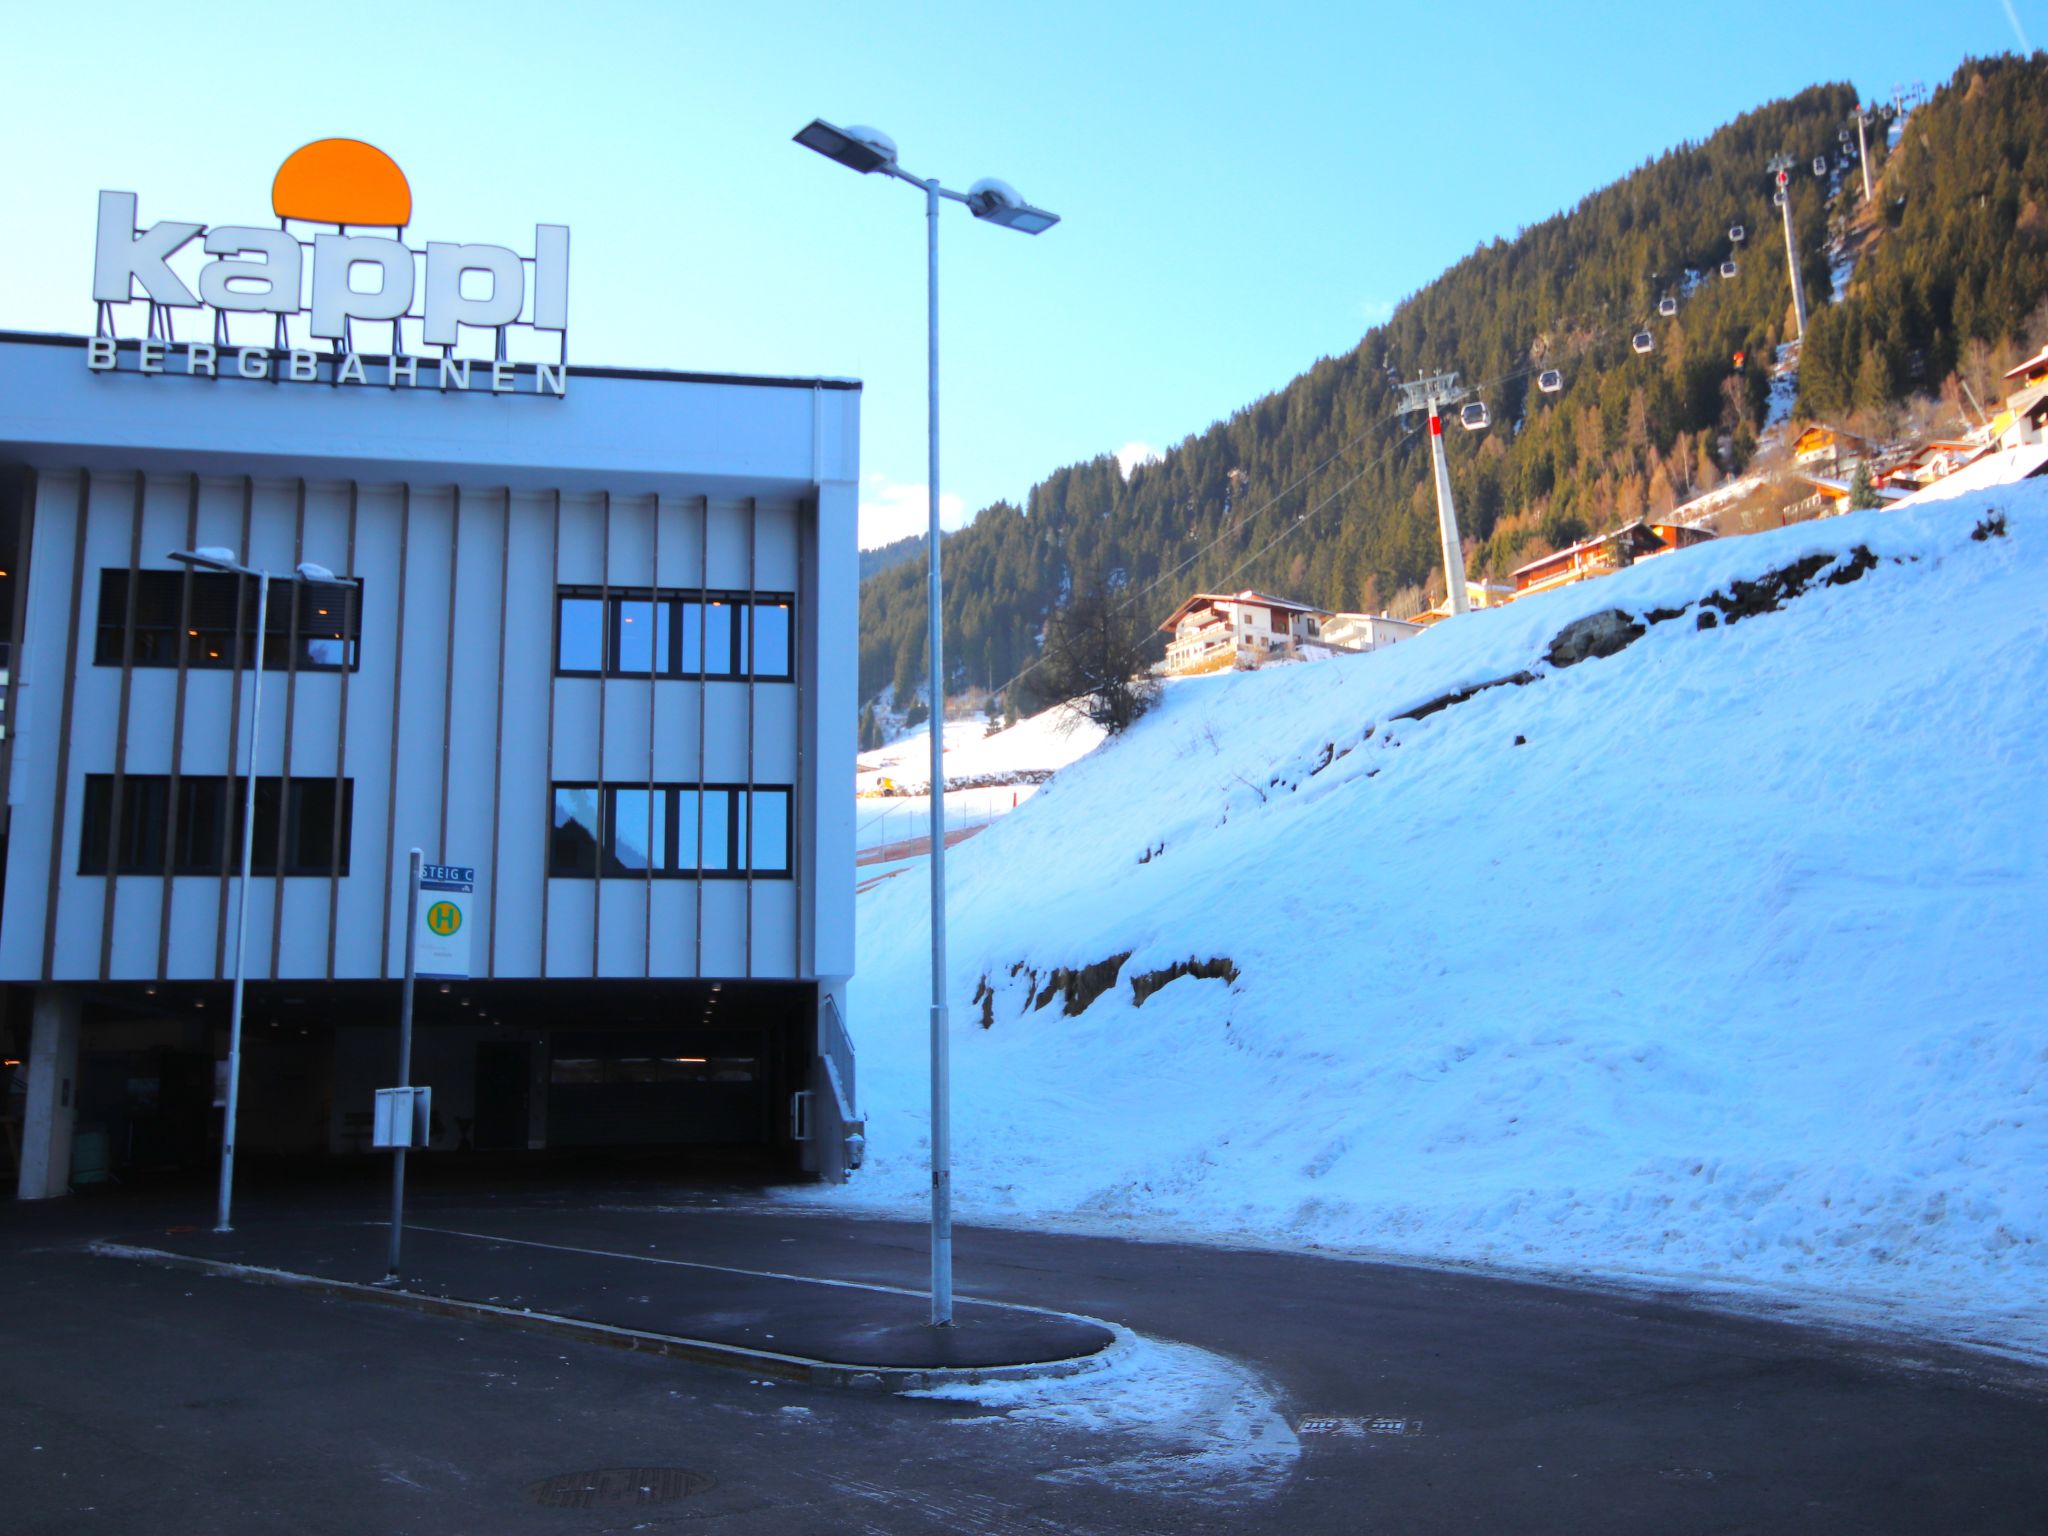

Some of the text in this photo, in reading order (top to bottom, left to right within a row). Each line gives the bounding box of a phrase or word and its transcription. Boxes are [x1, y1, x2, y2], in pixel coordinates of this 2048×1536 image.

[93, 190, 569, 345] kappl
[87, 337, 567, 395] BERGBAHNEN
[421, 866, 459, 880] STEIG
[436, 907, 454, 929] H
